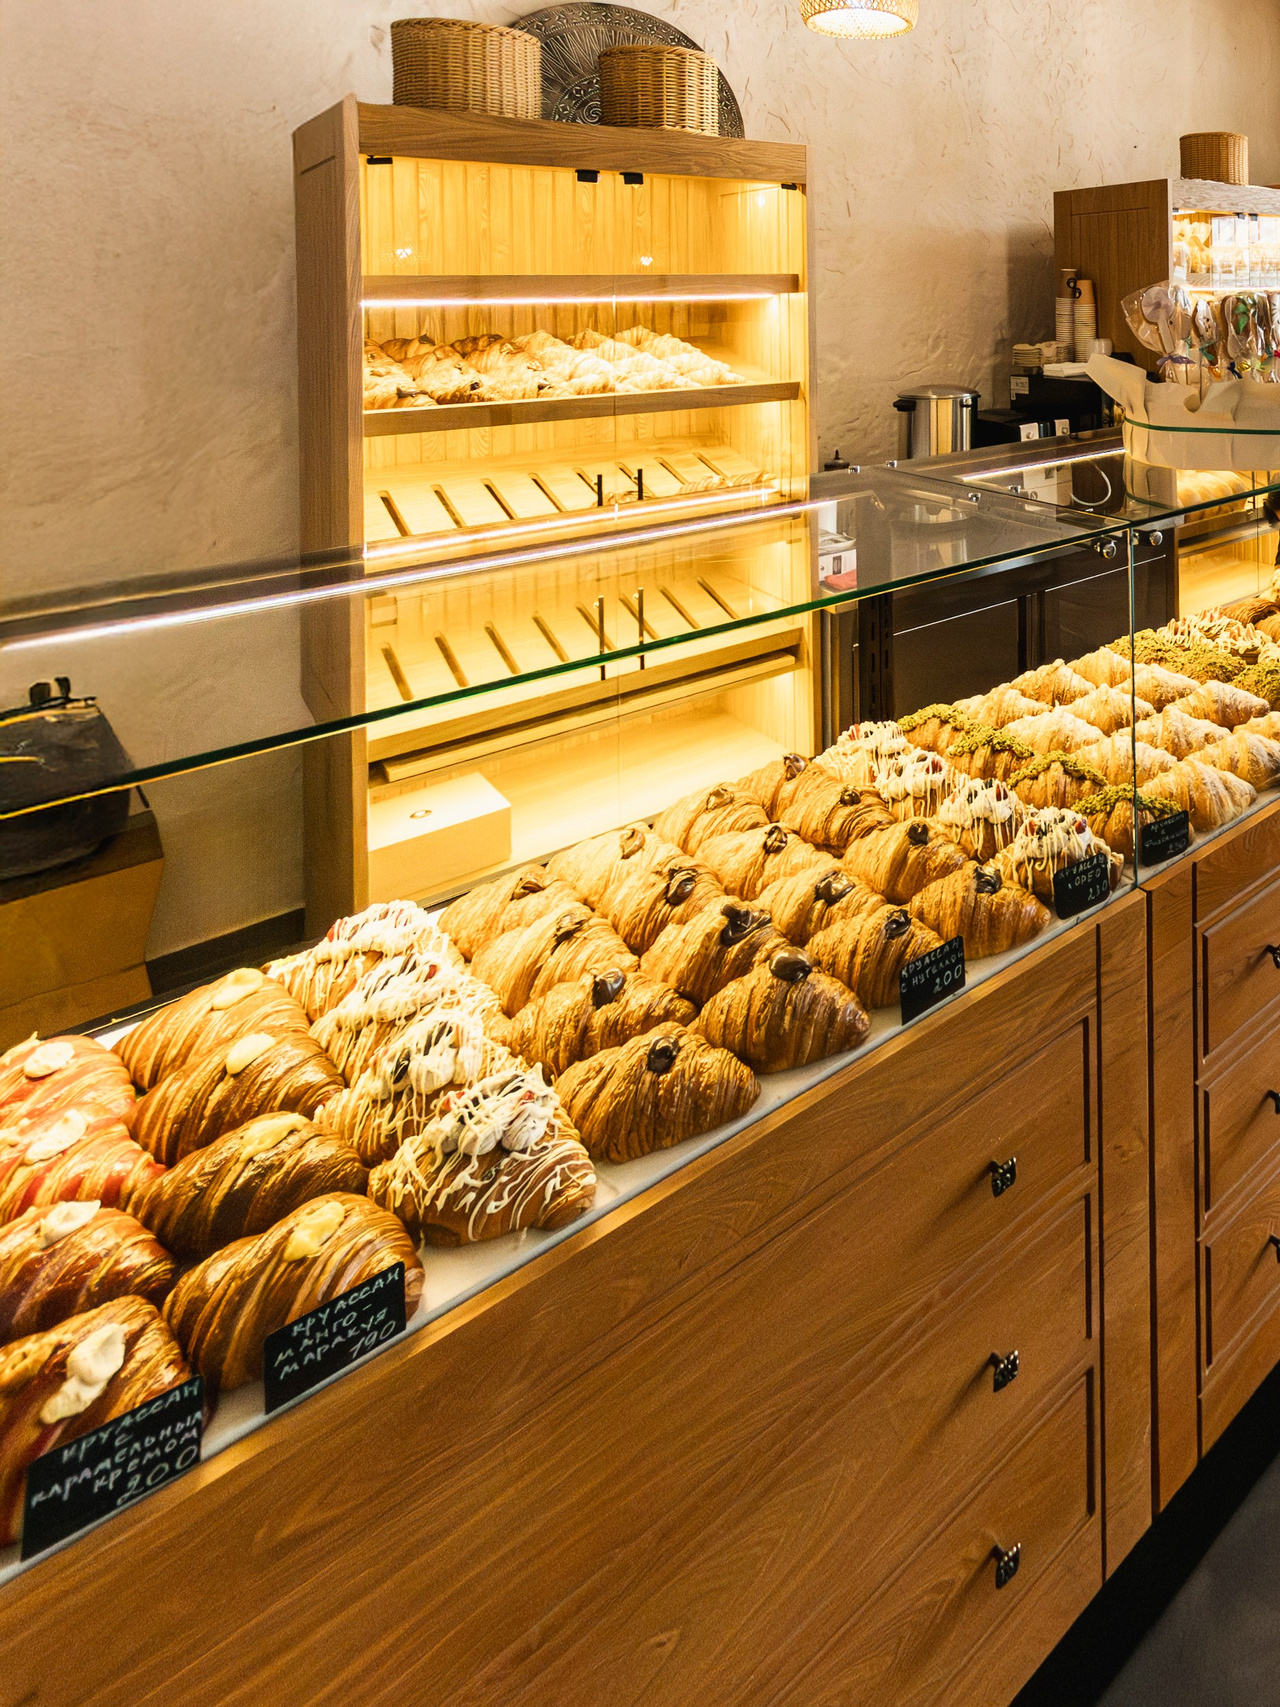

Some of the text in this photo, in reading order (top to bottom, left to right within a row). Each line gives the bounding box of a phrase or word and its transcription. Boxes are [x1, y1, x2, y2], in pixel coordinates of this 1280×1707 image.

[901, 938, 960, 978] КРУАССАН
[933, 964, 962, 994] 200
[291, 1268, 400, 1337] КРУАССАН
[279, 1307, 388, 1380] МАРАКУЯ
[350, 1320, 397, 1359] 190
[62, 1380, 200, 1464] КРУАССАН
[93, 1427, 198, 1493] КРЕМОМ
[116, 1445, 198, 1507] 200
